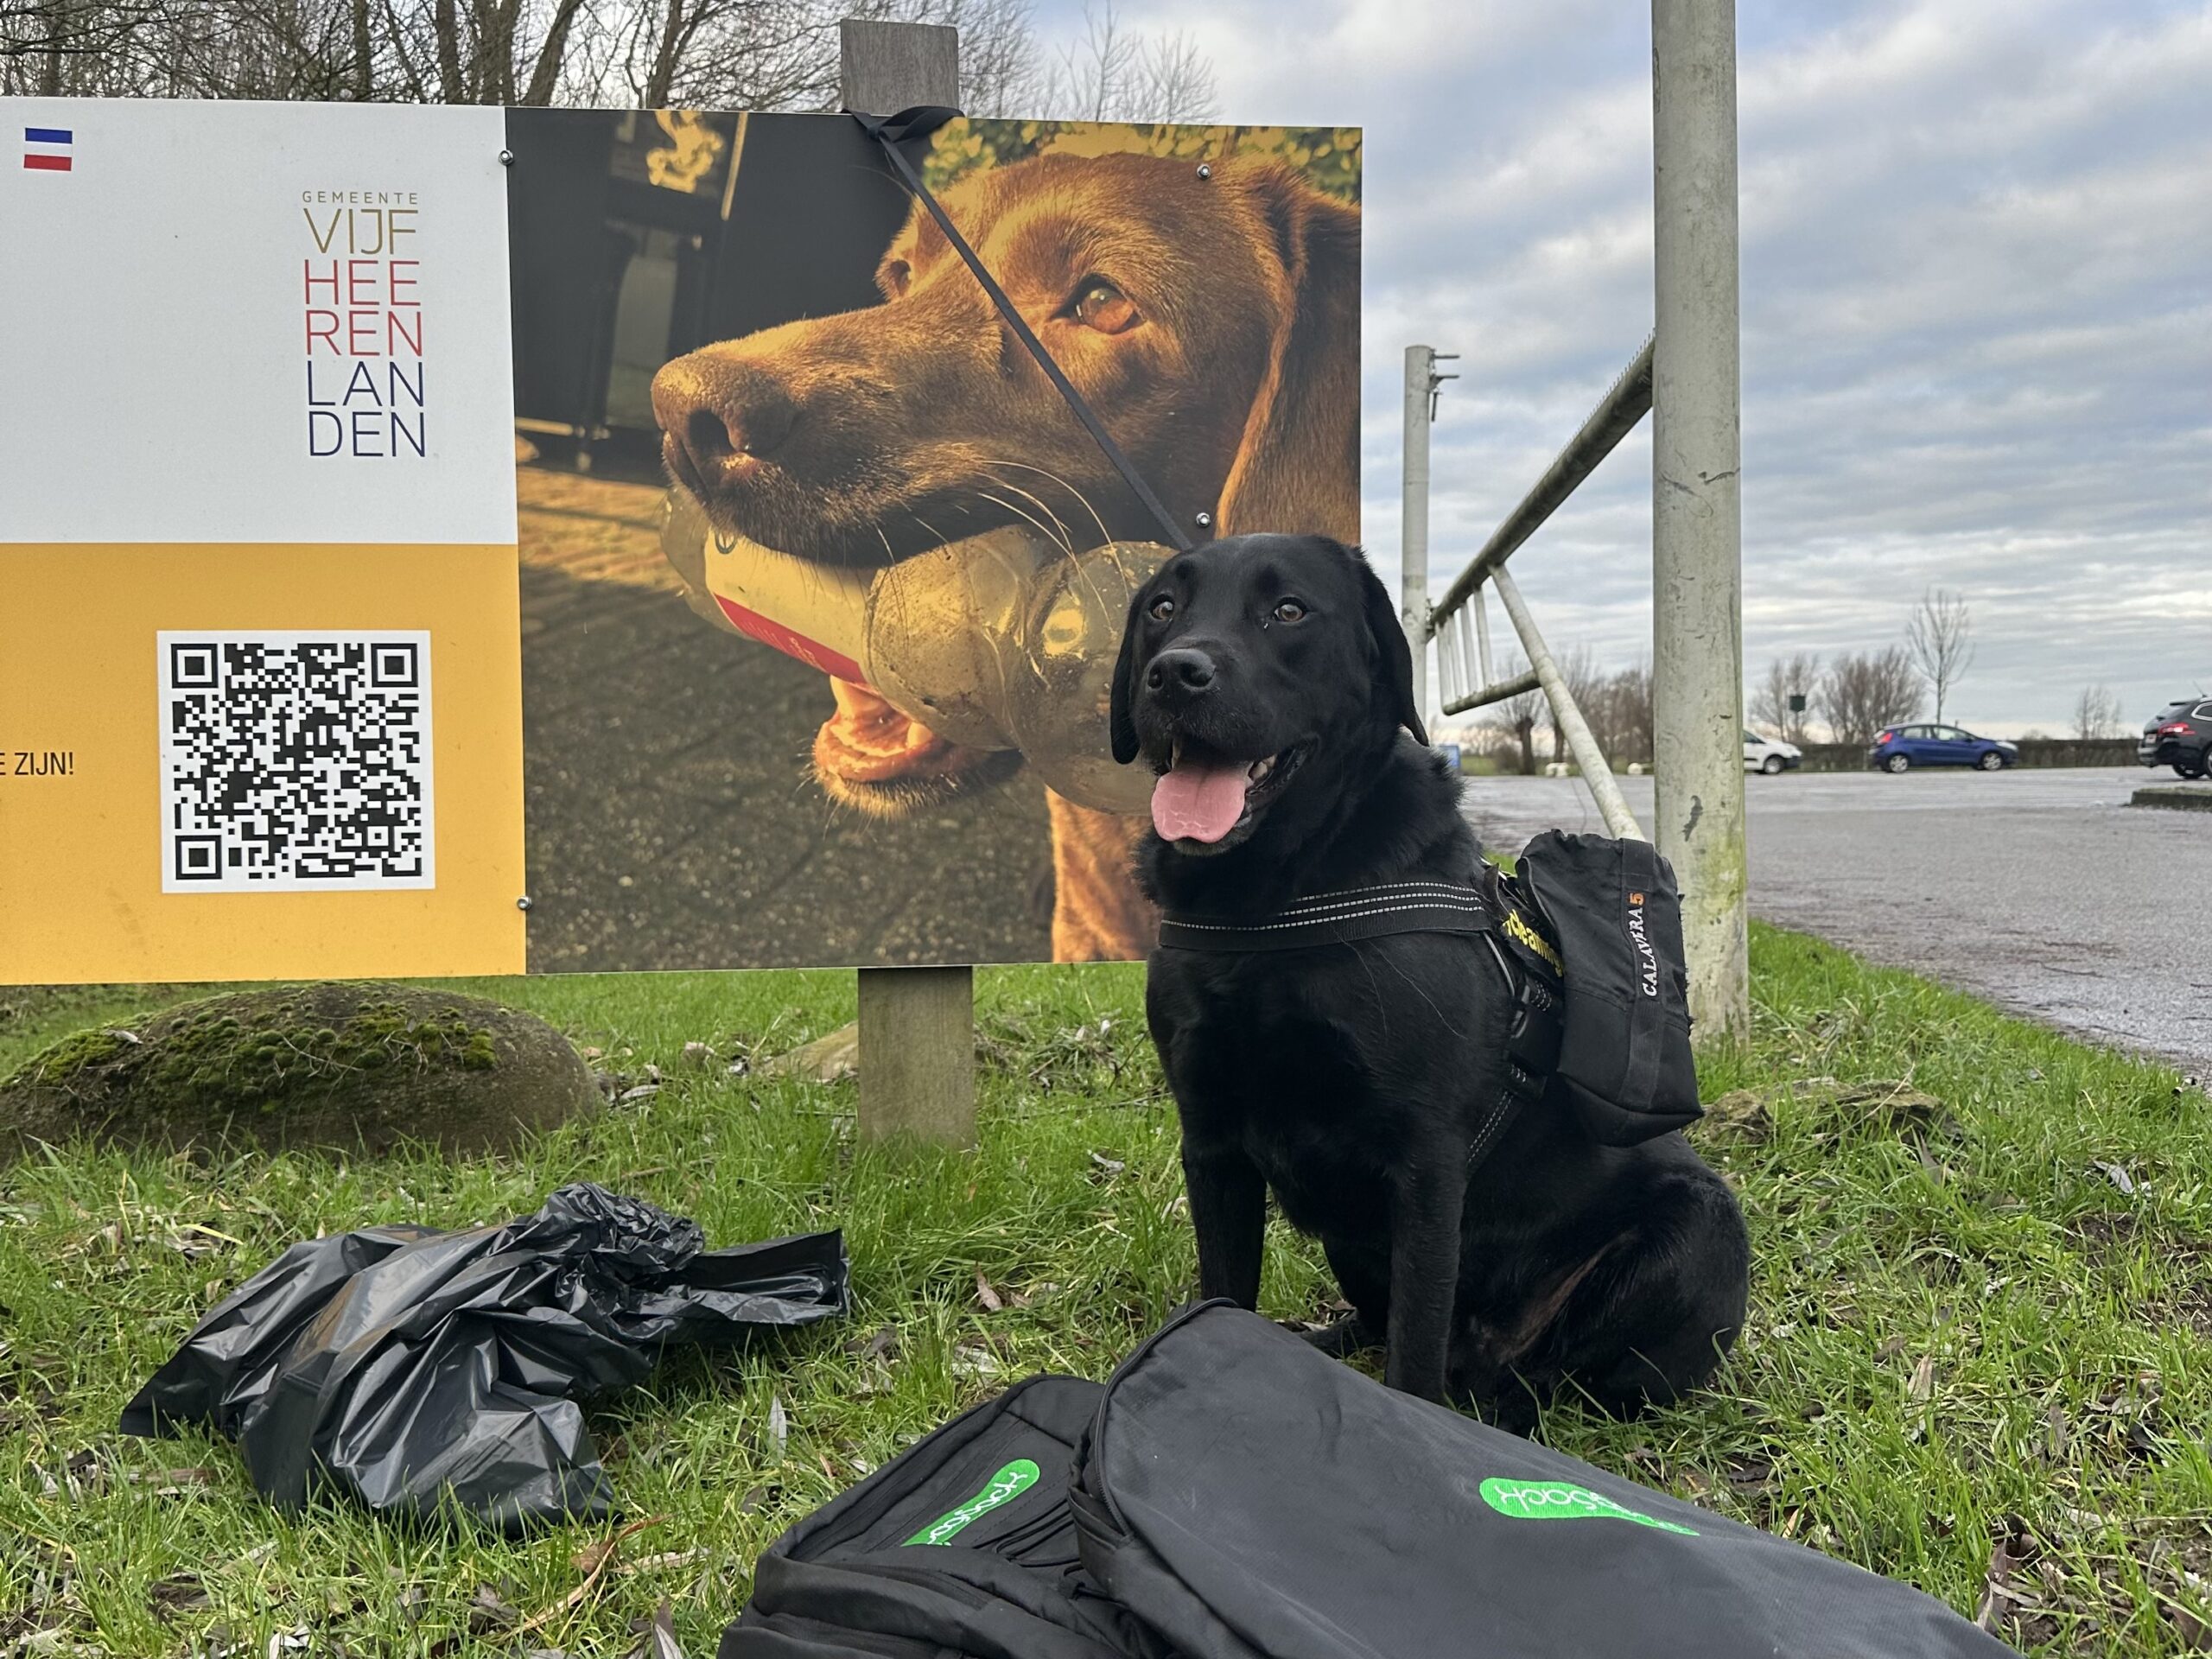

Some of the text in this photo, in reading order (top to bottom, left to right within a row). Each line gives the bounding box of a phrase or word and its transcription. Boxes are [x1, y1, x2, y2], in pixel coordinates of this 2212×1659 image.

[302, 191, 417, 204] GEMEENTE
[303, 208, 418, 255] VIJF
[304, 259, 421, 306] HEE
[306, 309, 423, 357] REN
[307, 360, 423, 407] LAN
[308, 410, 425, 457] DEN
[14, 752, 73, 775] ZIJN!
[1627, 893, 1658, 997] CALAVERA 5
